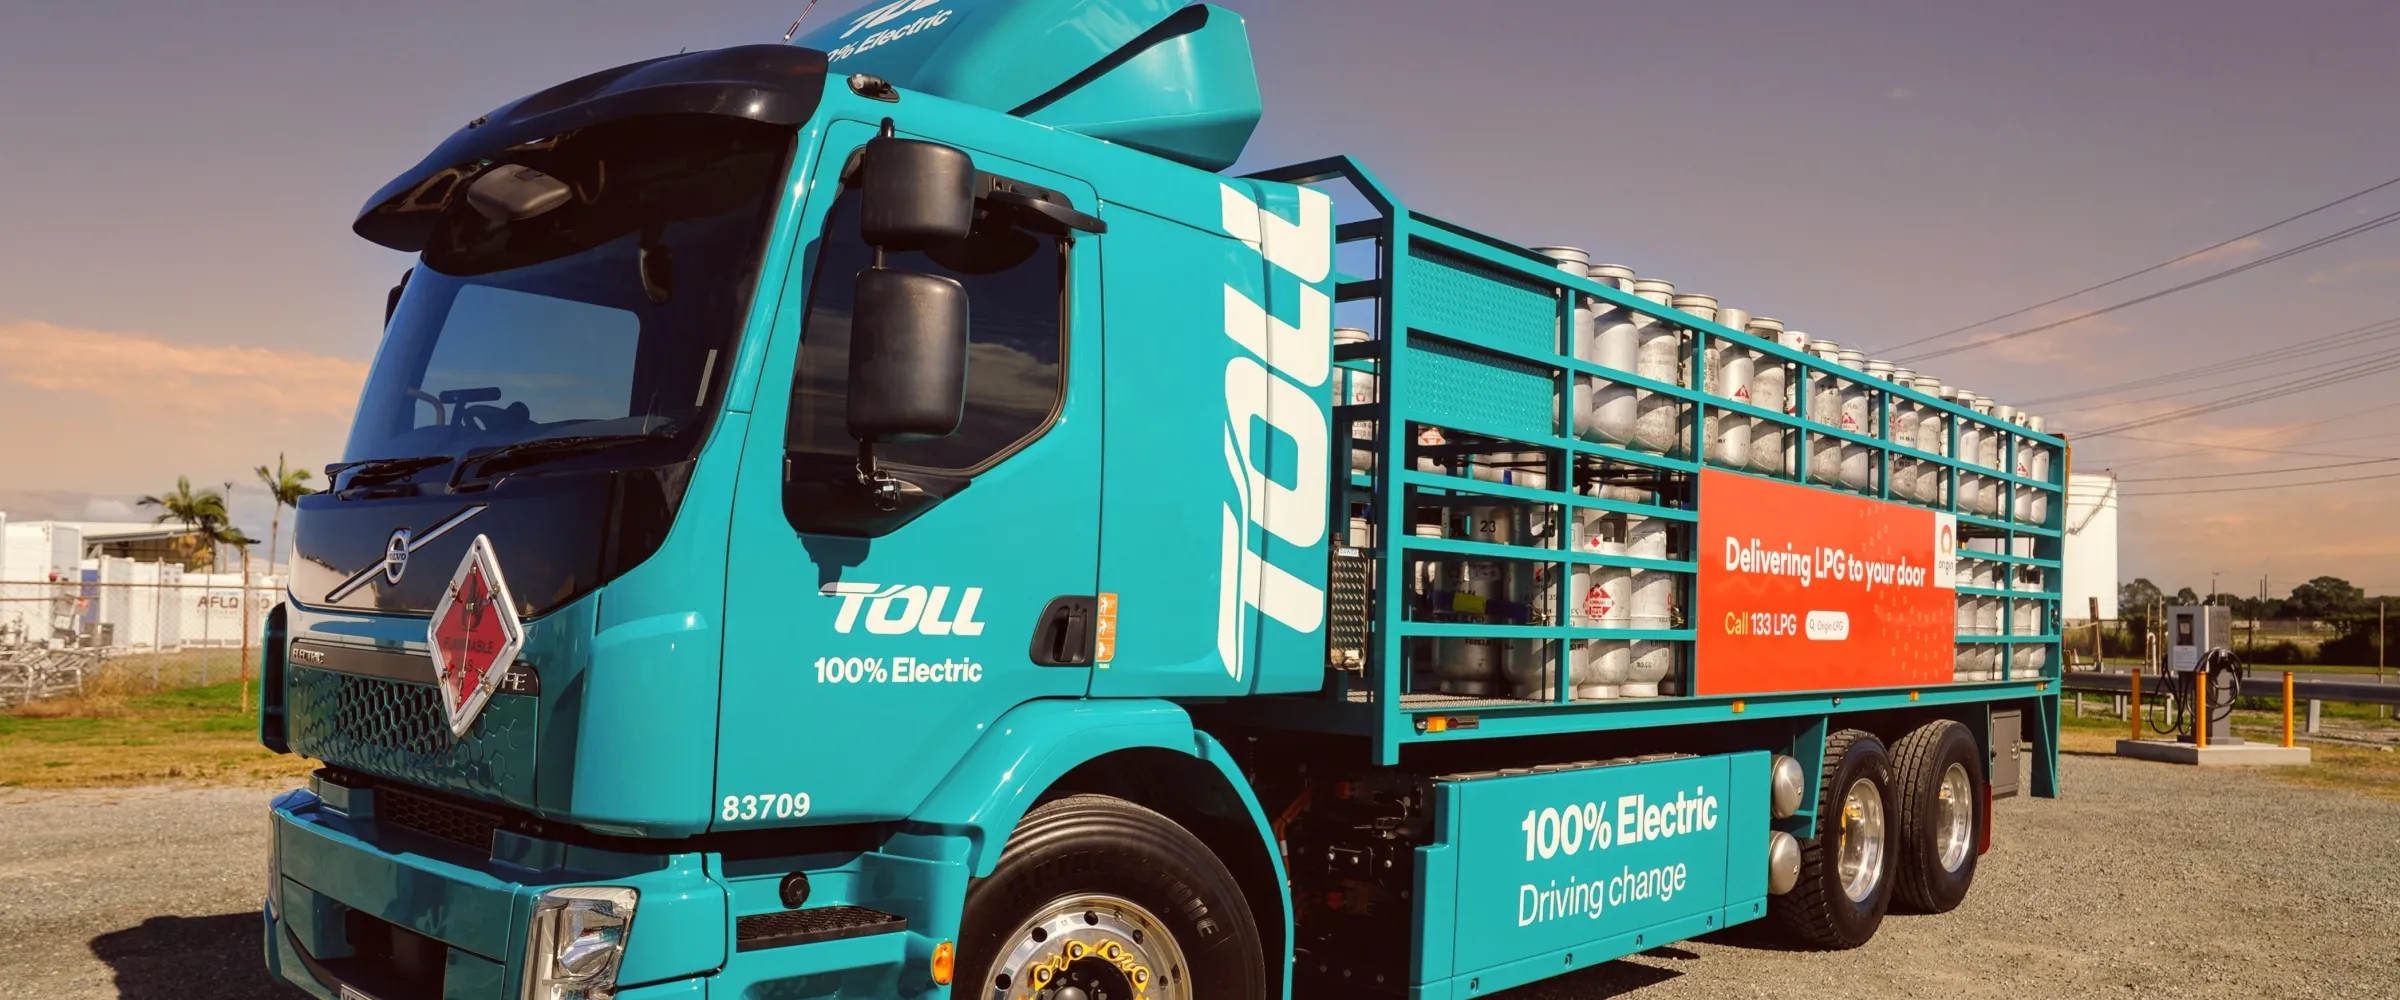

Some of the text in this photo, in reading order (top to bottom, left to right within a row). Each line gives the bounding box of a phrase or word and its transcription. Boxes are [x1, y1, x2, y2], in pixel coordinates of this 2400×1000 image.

[854, 9, 953, 55] Electric
[1217, 181, 1331, 683] TOLL
[1480, 520, 1496, 533] 23
[1725, 536, 1926, 592] Delivering LPG to your door
[1938, 560, 1954, 576] origin
[818, 582, 986, 636] TOLL
[1725, 611, 1797, 636] Call 133 LPG
[814, 657, 983, 683] 100% Electric
[722, 792, 811, 821] 83709
[1521, 785, 1718, 862] 100% Electric
[1518, 862, 1687, 927] Driving change
